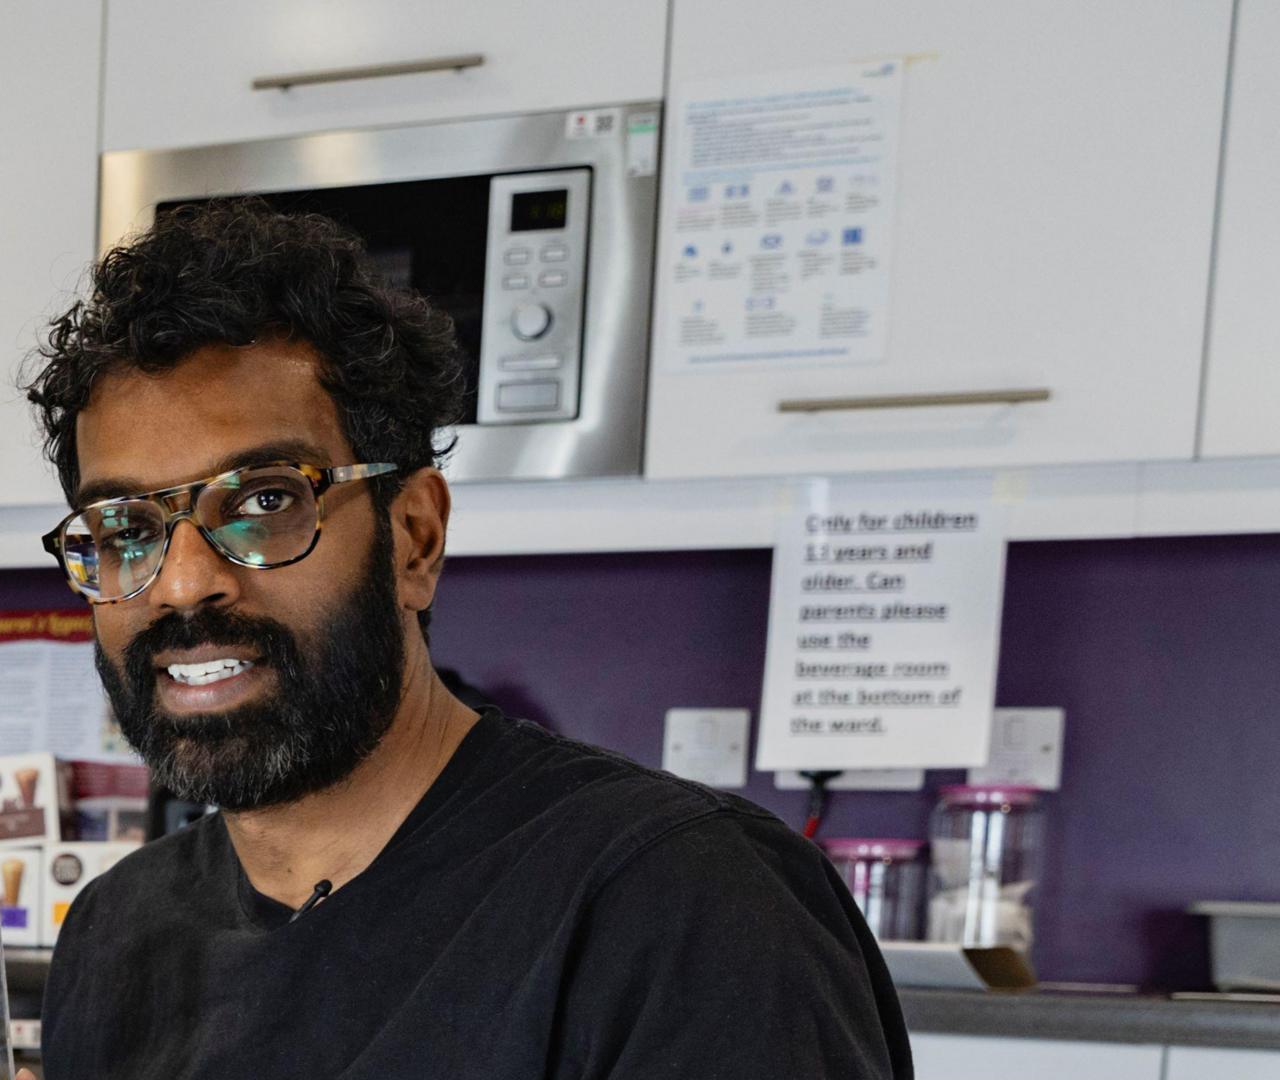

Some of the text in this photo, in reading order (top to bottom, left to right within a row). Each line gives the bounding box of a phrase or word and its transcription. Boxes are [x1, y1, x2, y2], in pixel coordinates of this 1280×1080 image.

[858, 513, 887, 531] for
[892, 511, 978, 530] children
[834, 545, 888, 562] years
[893, 541, 933, 560] and
[866, 571, 905, 590] Can
[799, 602, 948, 622] parents please
[797, 631, 871, 649] use the
[795, 660, 949, 679] beverage room
[794, 684, 963, 705] at the bottom of
[790, 716, 823, 733] the
